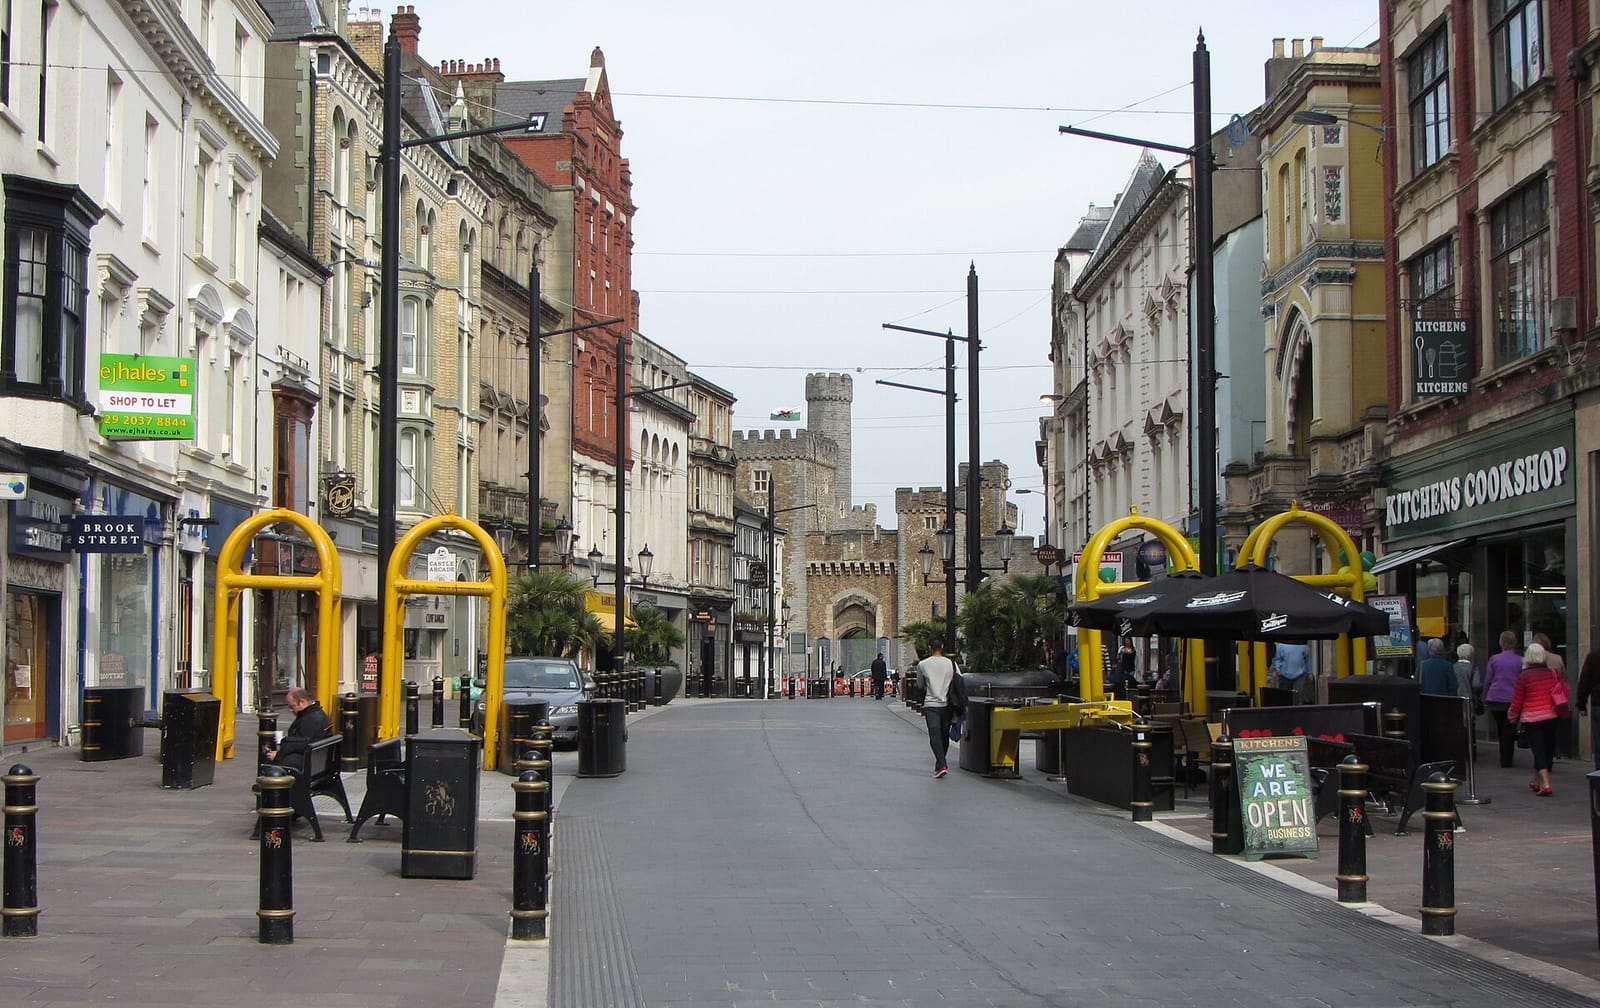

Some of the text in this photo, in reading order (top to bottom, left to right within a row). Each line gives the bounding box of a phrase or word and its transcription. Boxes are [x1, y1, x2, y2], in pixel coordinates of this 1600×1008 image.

[1415, 321, 1466, 332] KITCHENS
[100, 362, 166, 384] ejhales
[1416, 382, 1468, 393] KITCHENS
[110, 396, 176, 408] SHOP TO LET
[123, 415, 152, 425] 2037
[156, 417, 187, 427] 8844
[106, 427, 181, 436] www.ejhales.co.uk
[1385, 446, 1567, 526] KITCHENS COOKSHOP
[84, 523, 136, 533] BROOK
[78, 535, 140, 544] STREET
[1106, 554, 1121, 562] SALE
[1241, 739, 1300, 749] KITCHENS
[1260, 764, 1286, 778] WE
[1253, 780, 1297, 797] ARE
[1247, 799, 1308, 828] OPEN
[1267, 827, 1311, 839] BUSINESS
